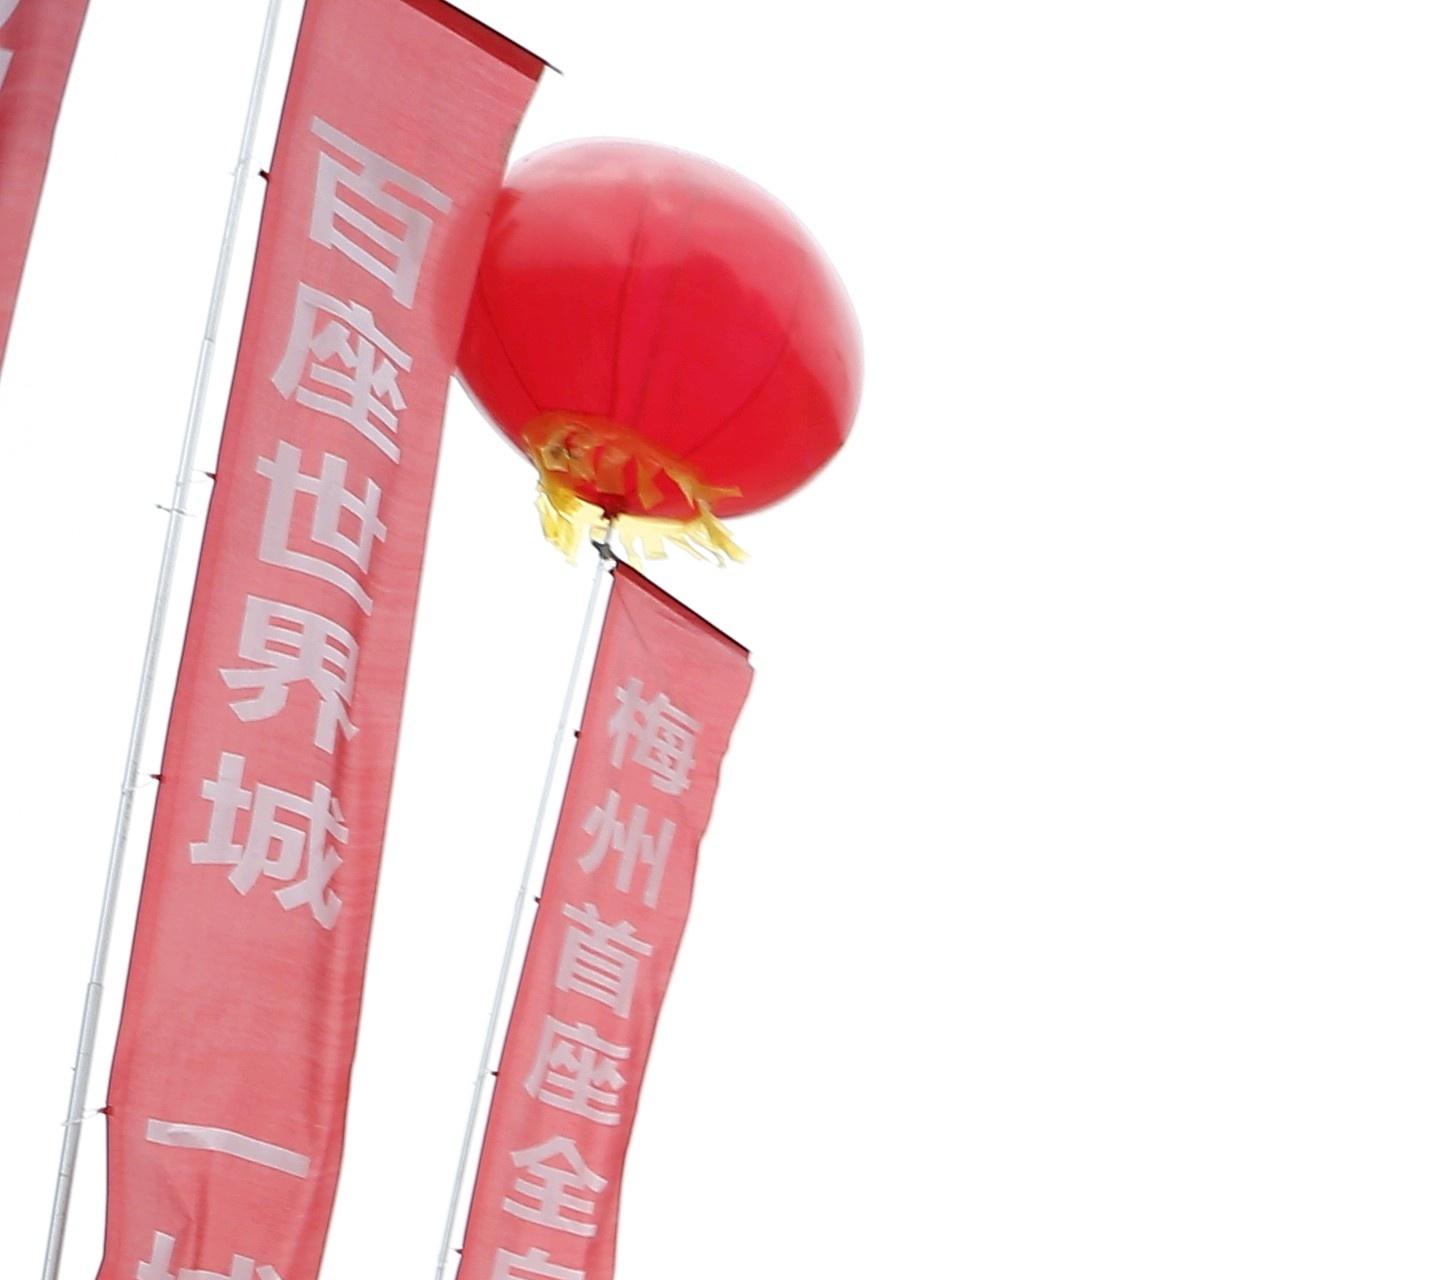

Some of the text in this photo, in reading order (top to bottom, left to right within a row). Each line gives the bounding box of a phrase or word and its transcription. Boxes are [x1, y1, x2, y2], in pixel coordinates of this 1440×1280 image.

[189, 116, 453, 931] 百座世界城
